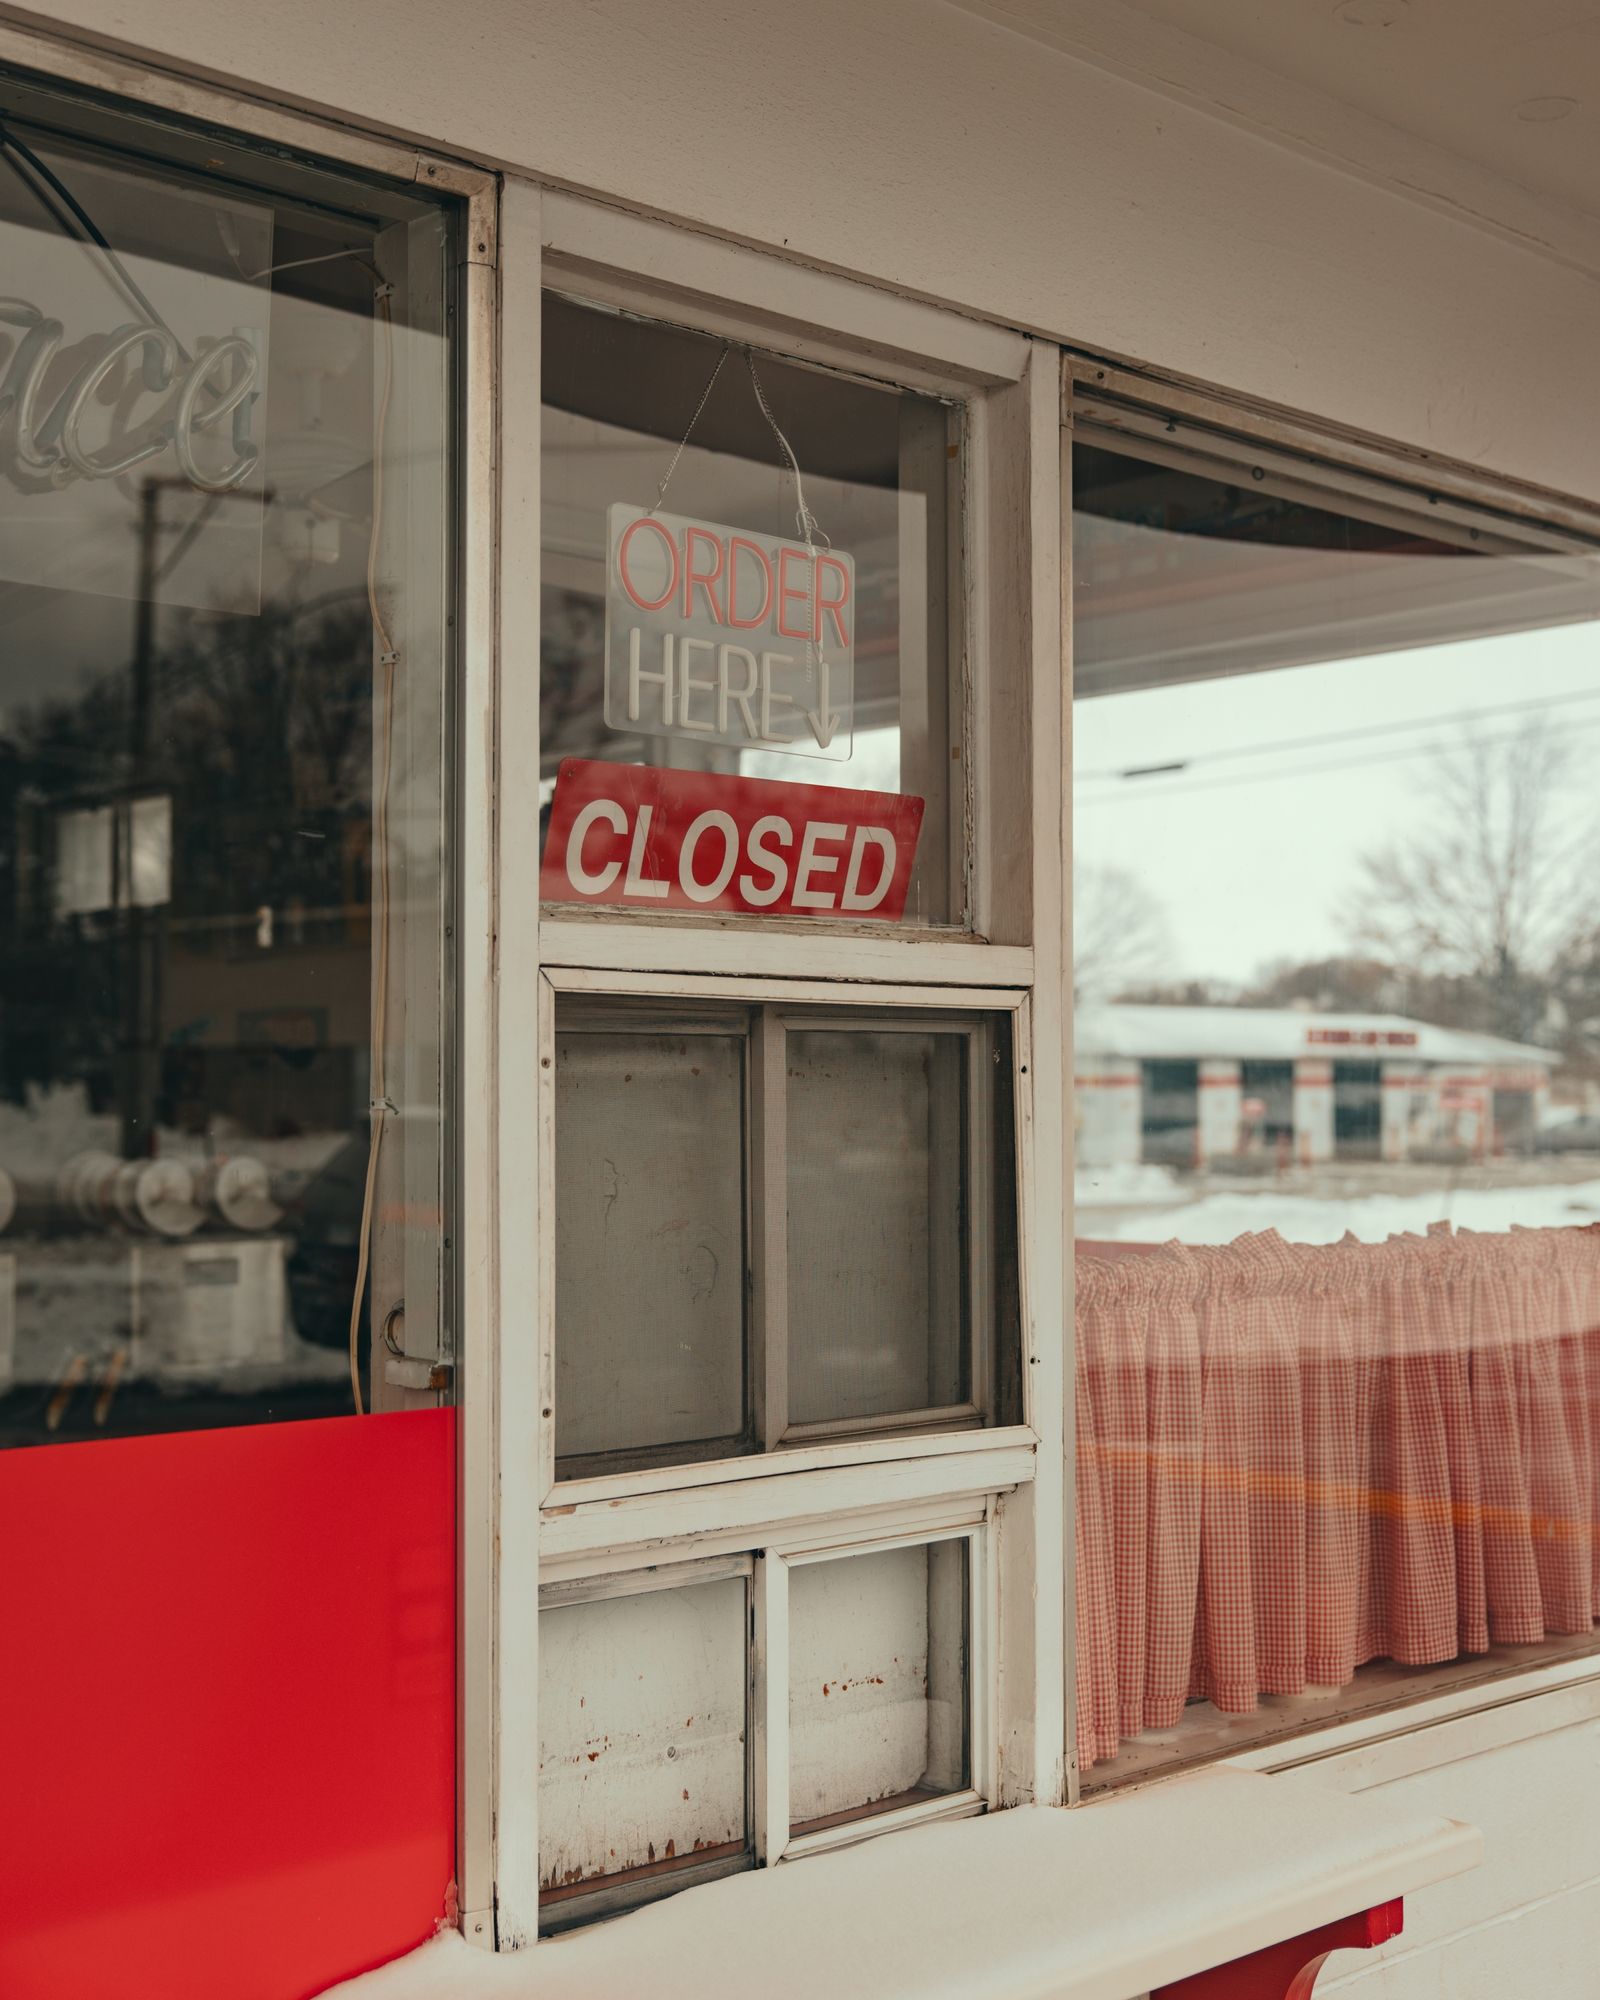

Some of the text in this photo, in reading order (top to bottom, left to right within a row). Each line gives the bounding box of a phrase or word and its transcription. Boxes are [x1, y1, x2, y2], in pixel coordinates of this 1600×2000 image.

[619, 518, 850, 648] ORDER
[628, 627, 795, 744] HERE
[566, 799, 897, 911] CLOSED
